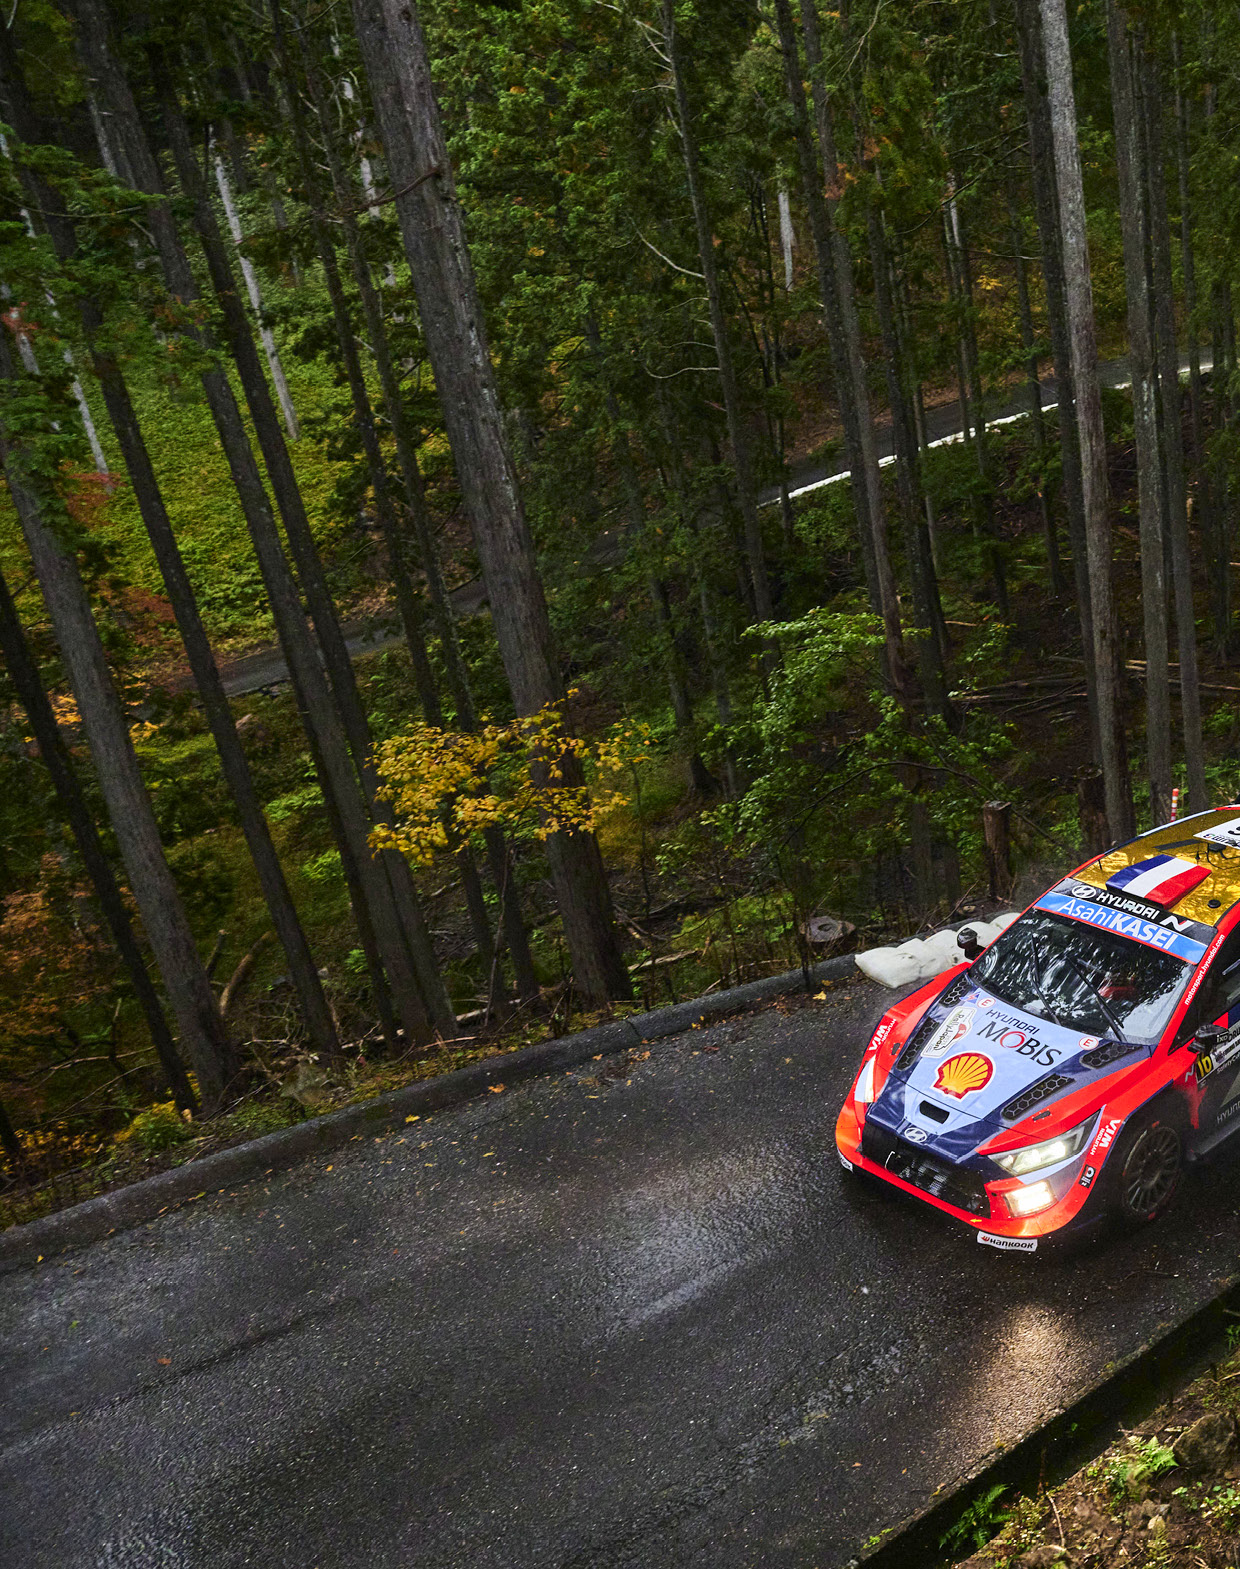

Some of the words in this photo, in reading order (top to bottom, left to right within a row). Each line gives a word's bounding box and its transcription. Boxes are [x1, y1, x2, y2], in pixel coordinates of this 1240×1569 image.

[1096, 892, 1160, 920] HYUNDAI
[1056, 899, 1179, 950] AsahiKASEI
[1184, 934, 1226, 1006] motorsport.hyundai.com
[985, 1009, 1041, 1035] HYUNDAI
[868, 1024, 888, 1051] WIA
[976, 1021, 1063, 1067] MOBIS
[1090, 1127, 1106, 1156] HYUNDAI
[1099, 1119, 1122, 1148] WIA
